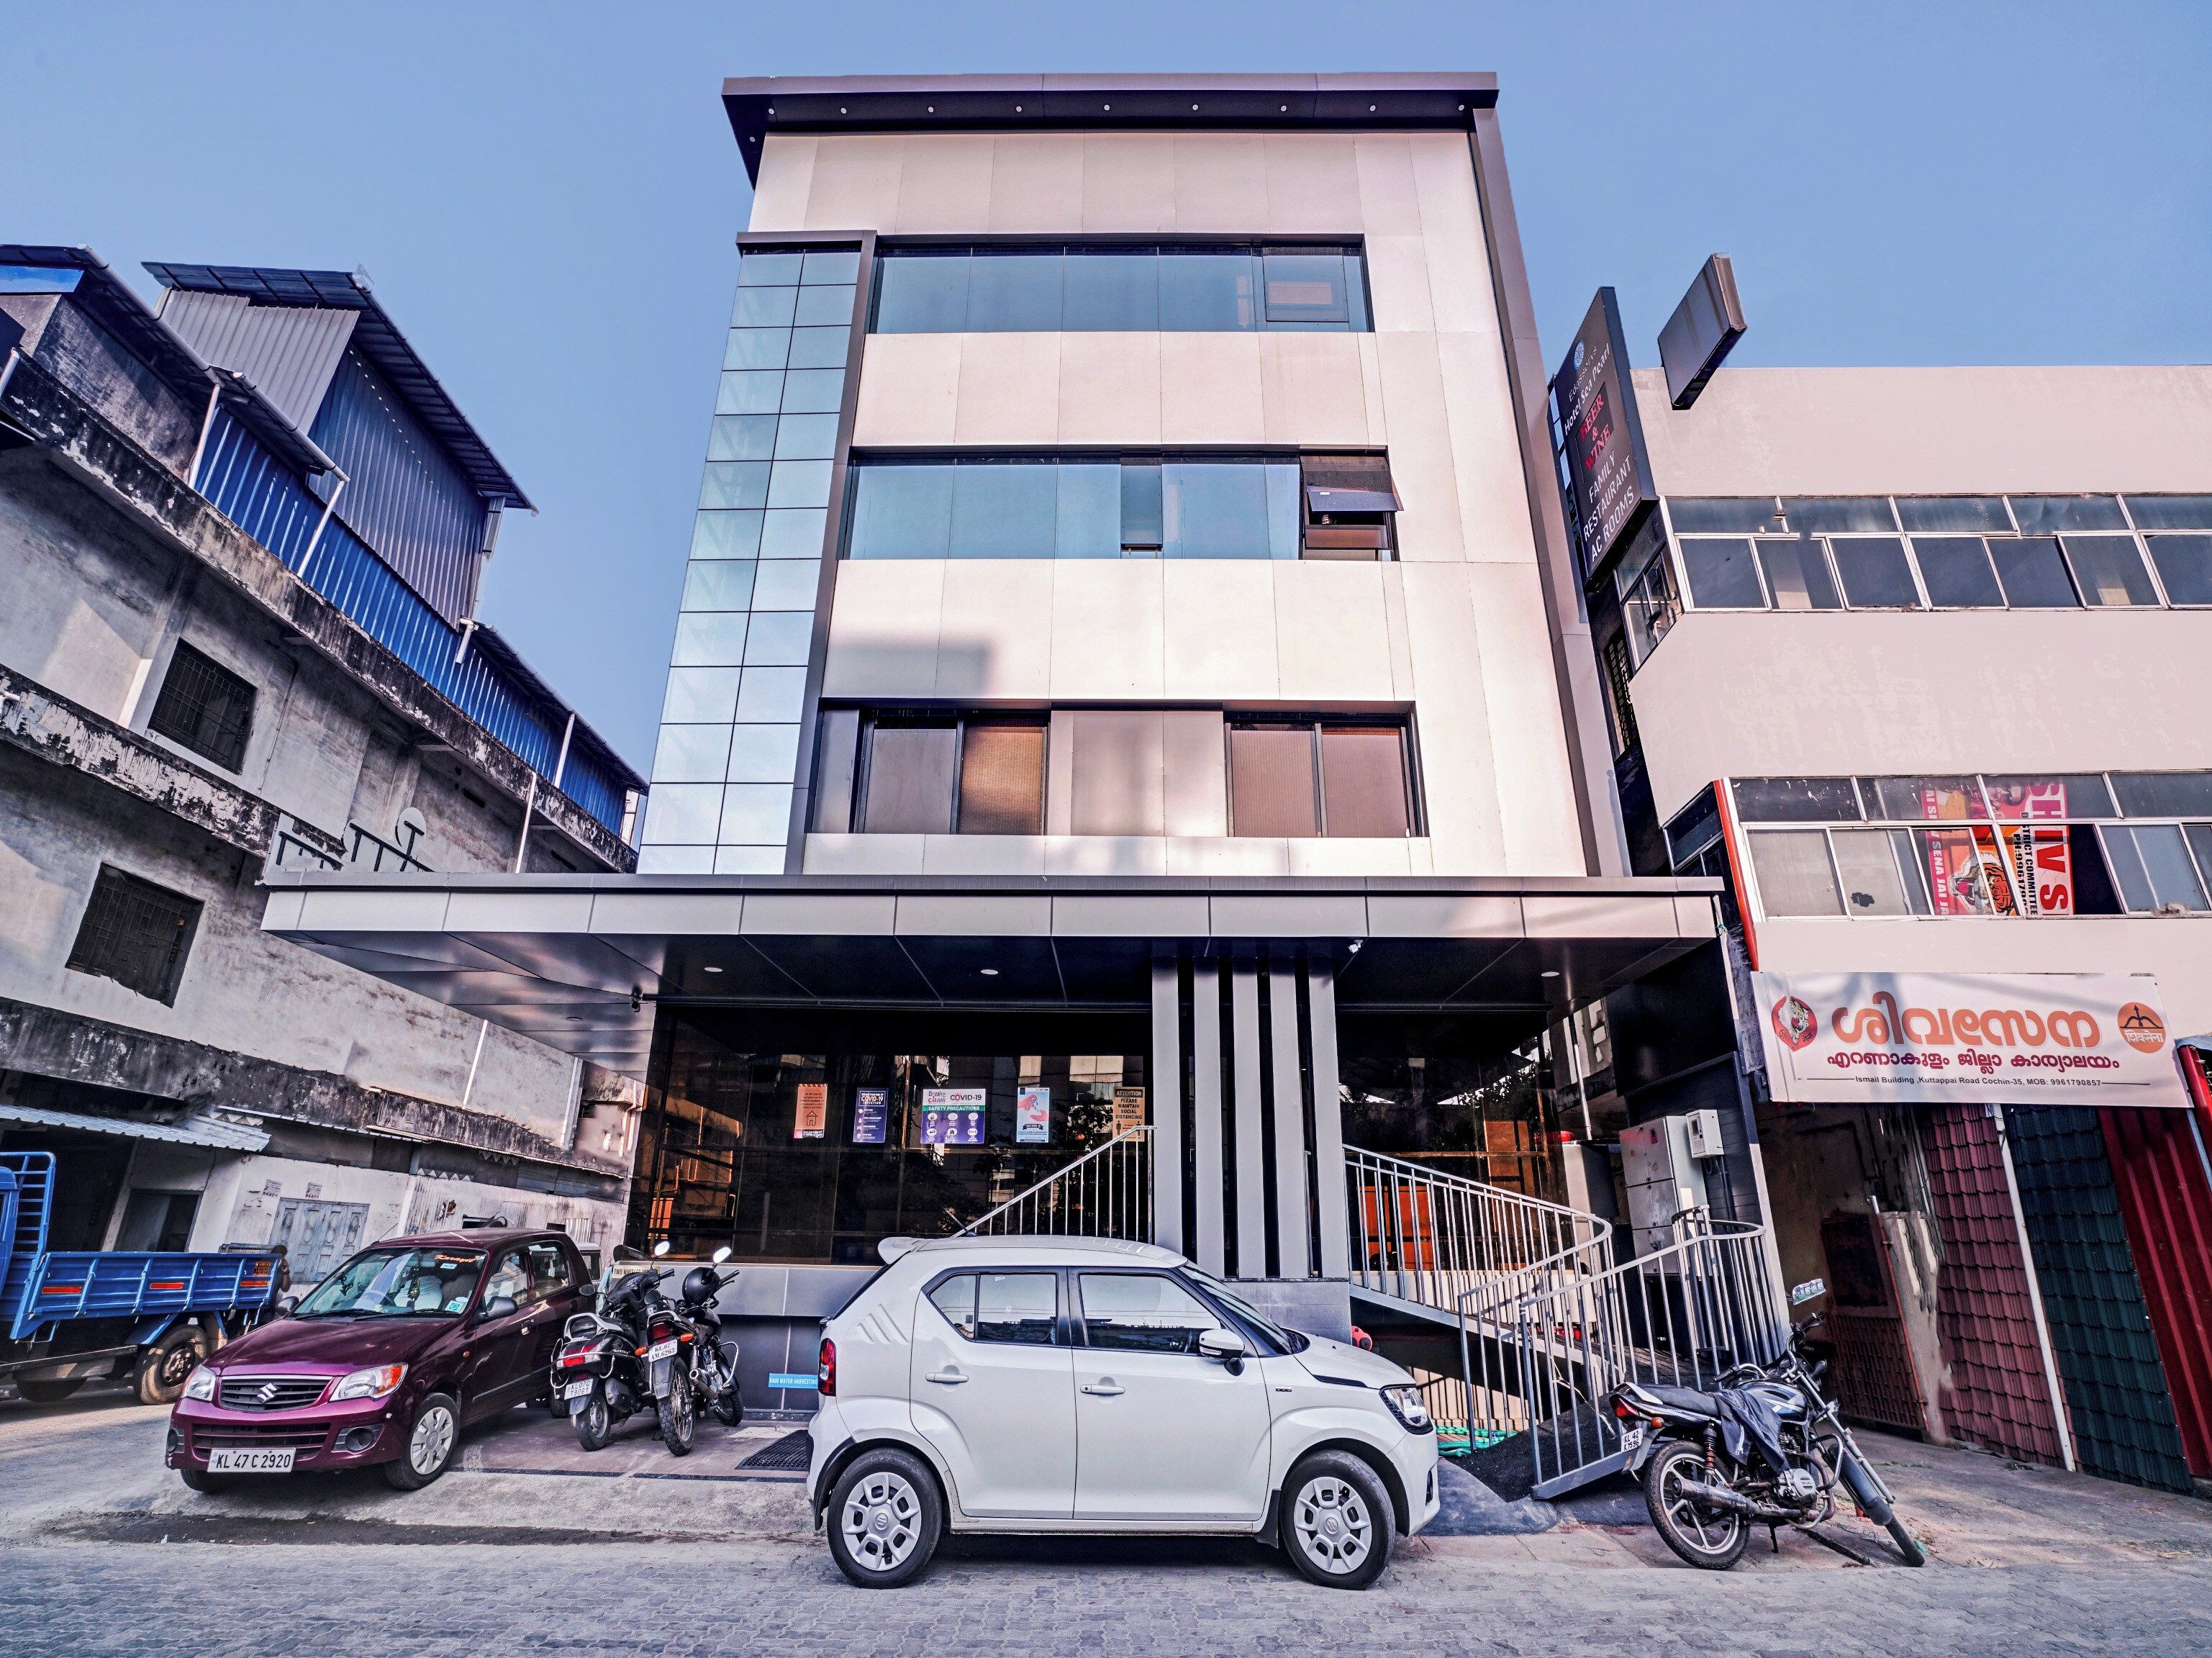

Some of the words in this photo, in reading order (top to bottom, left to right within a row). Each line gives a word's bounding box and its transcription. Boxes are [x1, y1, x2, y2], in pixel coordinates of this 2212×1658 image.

[1564, 398, 1582, 436] Hotel
[1581, 379, 1592, 404] Sea
[1592, 343, 1610, 381] Pearl
[1592, 426, 1598, 442] &
[1589, 450, 1615, 504] FAMILY
[1584, 455, 1631, 542] RESTAURANT
[1592, 535, 1603, 563] AC
[1603, 485, 1634, 543] ROOMS
[1932, 841, 1944, 875] SENA
[1936, 878, 1948, 897] JAI
[2025, 859, 2038, 915] COMMITTEE
[1831, 991, 2100, 1047] ശിവസേന
[1827, 1051, 1950, 1069] എറണാകുളം
[1957, 1048, 2002, 1074] ജില്ലാ
[2011, 1054, 2120, 1073] കാര്യാലയം
[1982, 1077, 2025, 1086] Cochin-35,
[1624, 1434, 1631, 1443] KL
[216, 1454, 230, 1468] KL
[234, 1454, 249, 1468] 47
[251, 1454, 258, 1467] C
[260, 1454, 291, 1468] 2920
